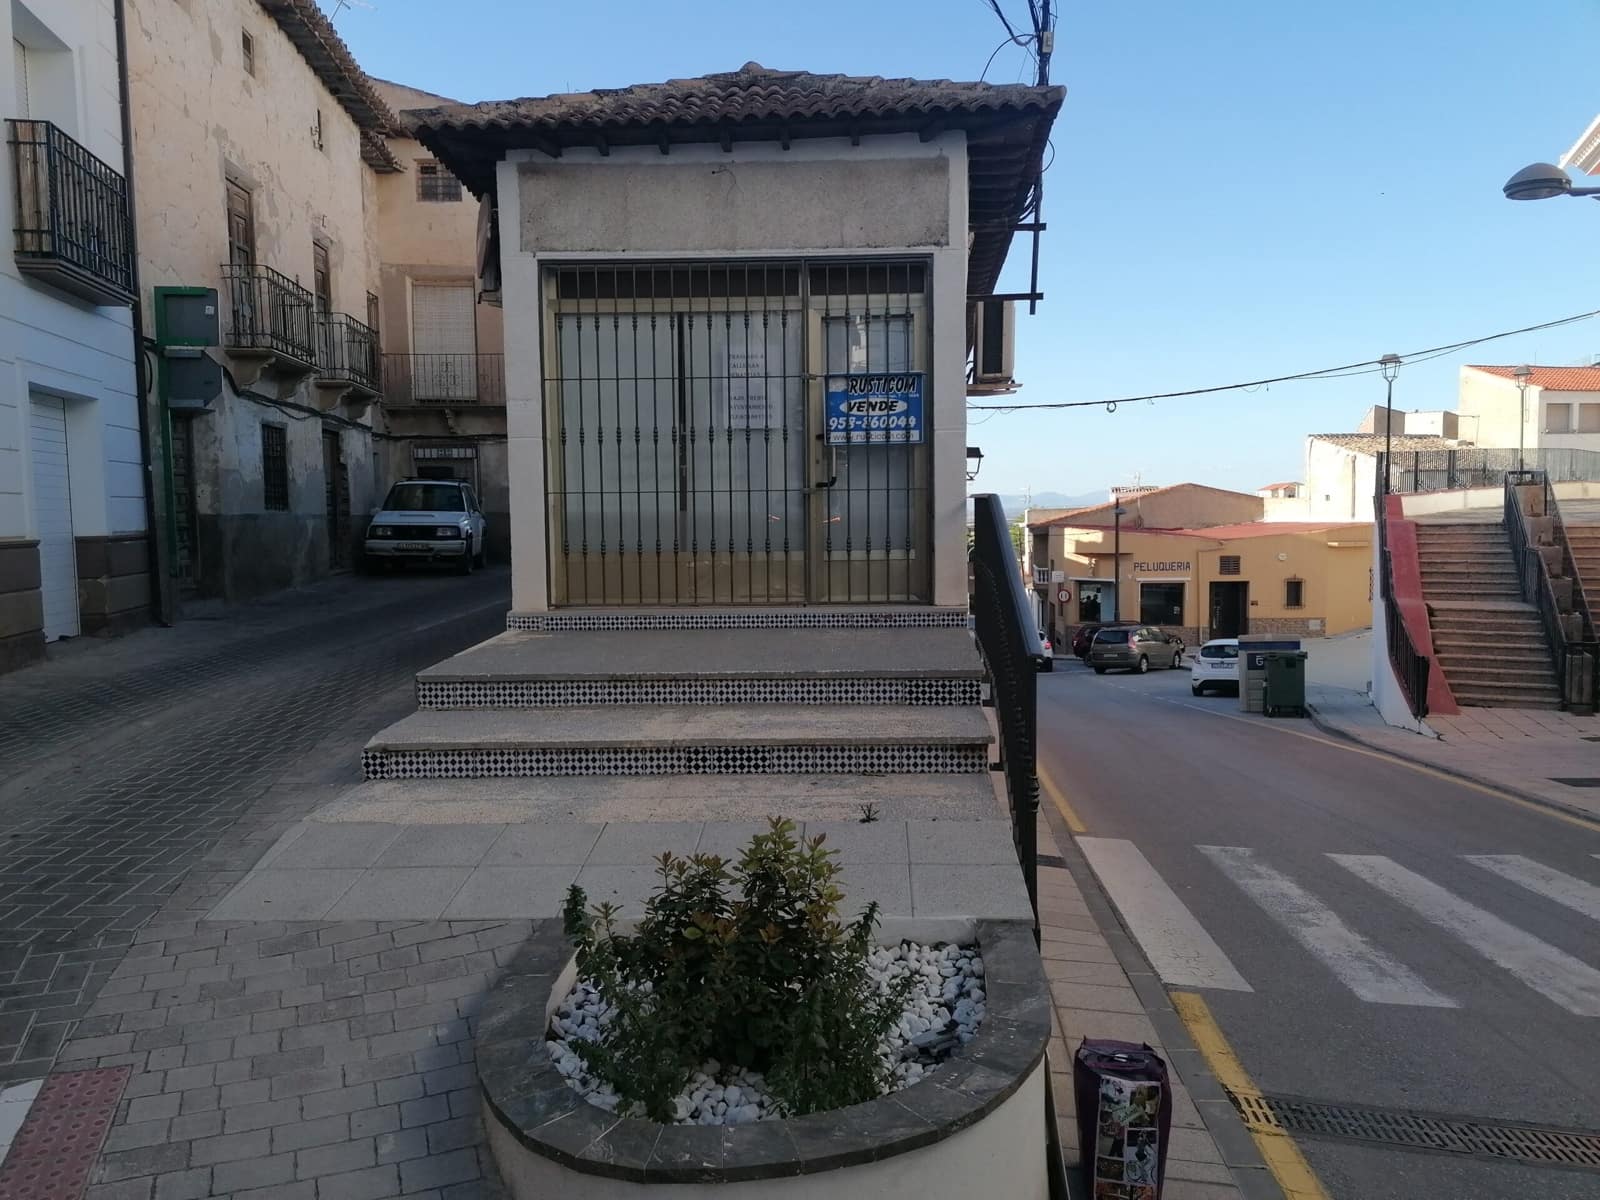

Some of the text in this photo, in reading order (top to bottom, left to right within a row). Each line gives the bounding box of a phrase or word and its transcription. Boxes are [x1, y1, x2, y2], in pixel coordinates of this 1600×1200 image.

[848, 376, 917, 395] RUSTICOM
[847, 400, 899, 412] VENDE
[1133, 561, 1191, 572] PELUQUERIA
